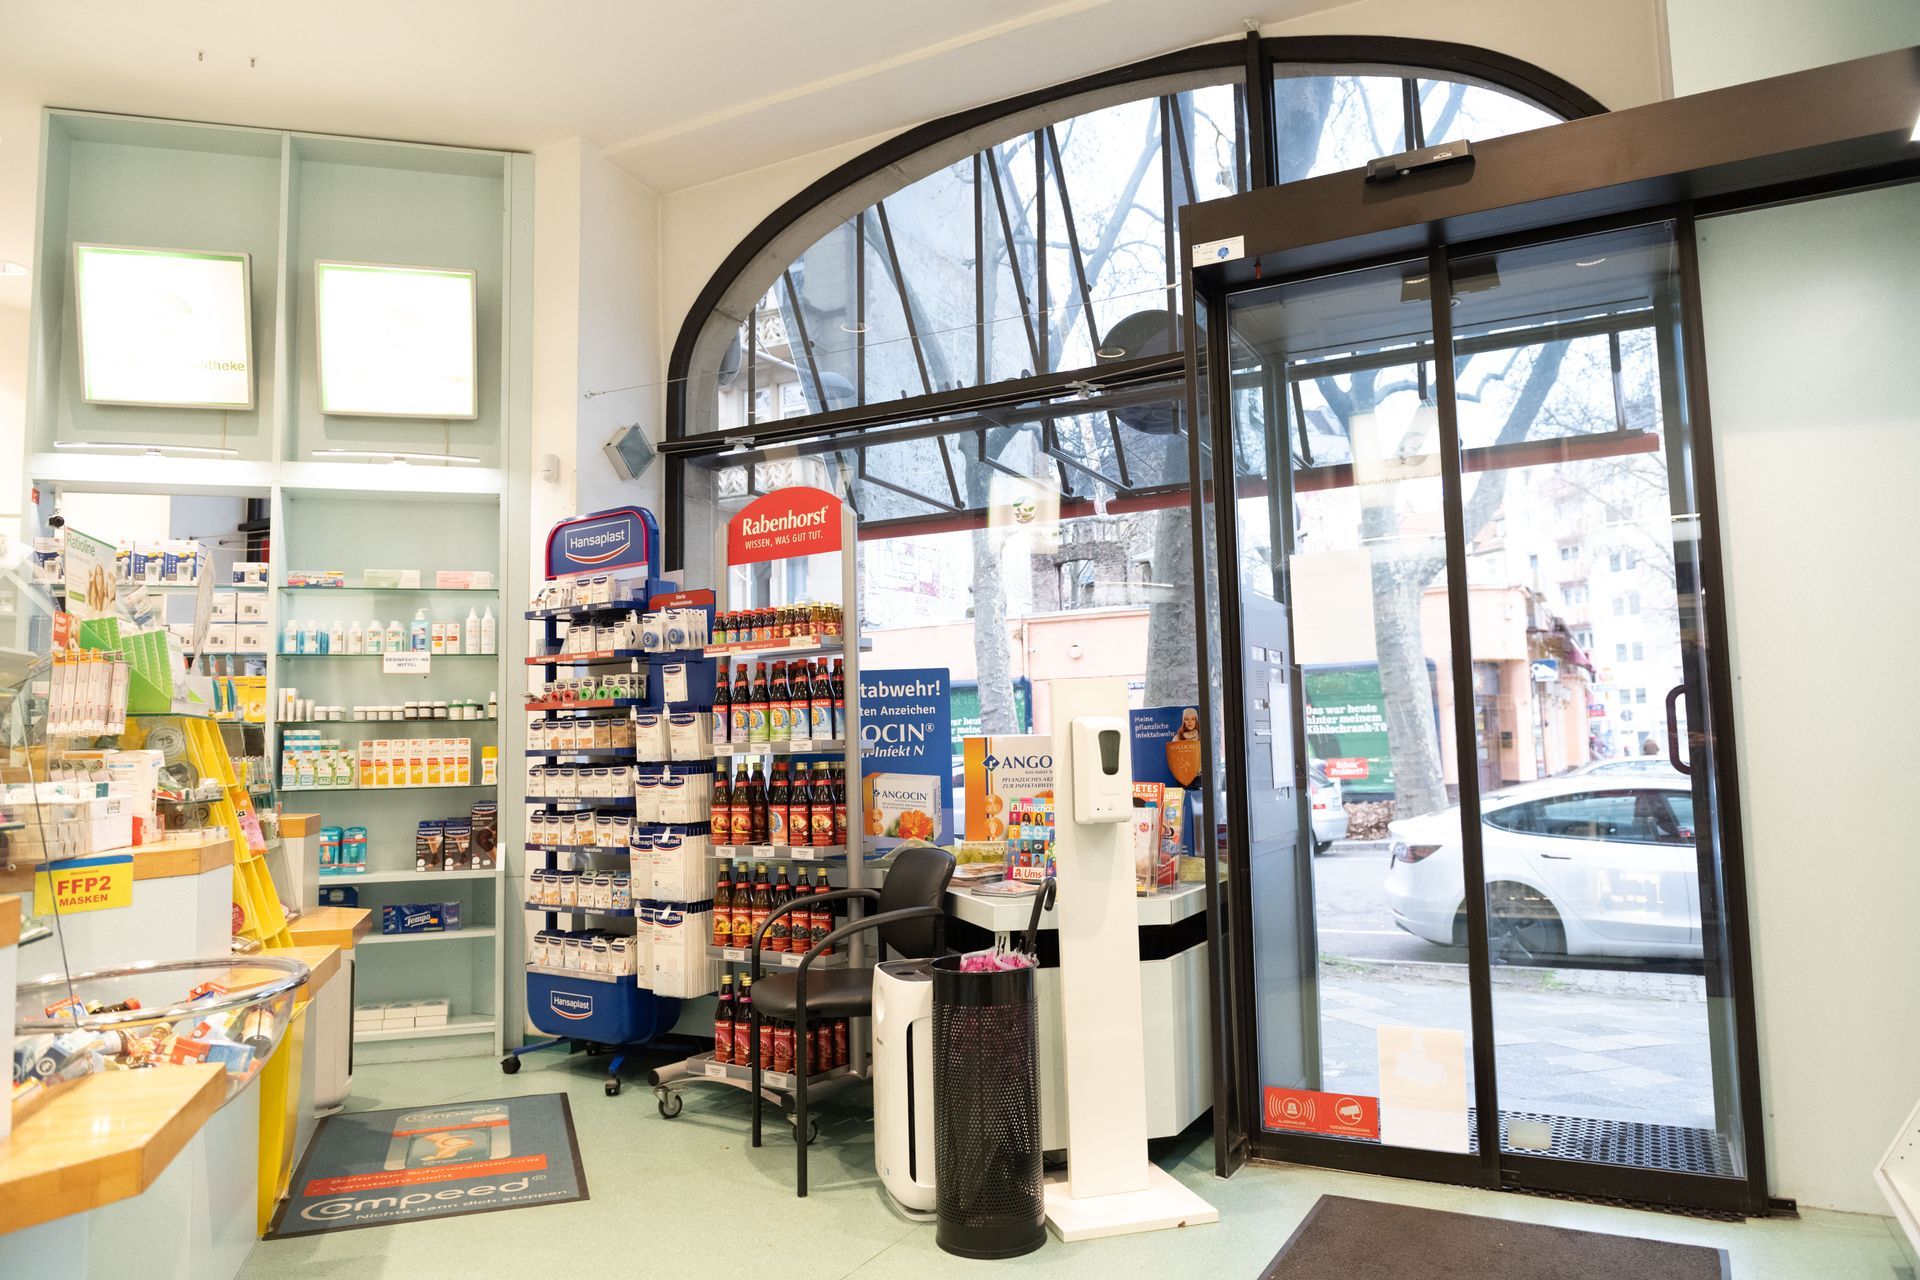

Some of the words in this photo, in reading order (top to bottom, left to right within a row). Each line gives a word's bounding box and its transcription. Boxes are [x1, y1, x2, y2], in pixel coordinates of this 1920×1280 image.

[570, 529, 625, 549] Hansaplast
[744, 538, 773, 550] WISSEN,
[775, 534, 790, 545] WAS
[792, 532, 806, 543] GUT
[808, 530, 824, 540] TUT.
[860, 680, 940, 698] tabwehr!
[860, 707, 877, 716] ten
[880, 705, 936, 716] Anzeichen
[1306, 705, 1324, 715] Das
[1325, 706, 1346, 714] war
[1347, 704, 1377, 713] heute
[1307, 715, 1338, 724] hinter
[1339, 714, 1382, 723] meinem
[1135, 723, 1169, 732] pflanzliche
[1307, 722, 1387, 734] Kühlschrank-Tü
[862, 745, 911, 758] -Infekt
[913, 745, 924, 756] N
[1002, 755, 1053, 768] ANGO
[1024, 868, 1042, 878] Ums
[57, 876, 111, 896] FFP2
[59, 894, 108, 907] MASKEN
[407, 913, 431, 926] Tempo
[553, 996, 590, 1010] Hansaplast
[416, 1173, 453, 1184] nicht
[355, 1209, 411, 1220] Nichts
[416, 1201, 459, 1213] kann
[463, 1198, 498, 1208] dich
